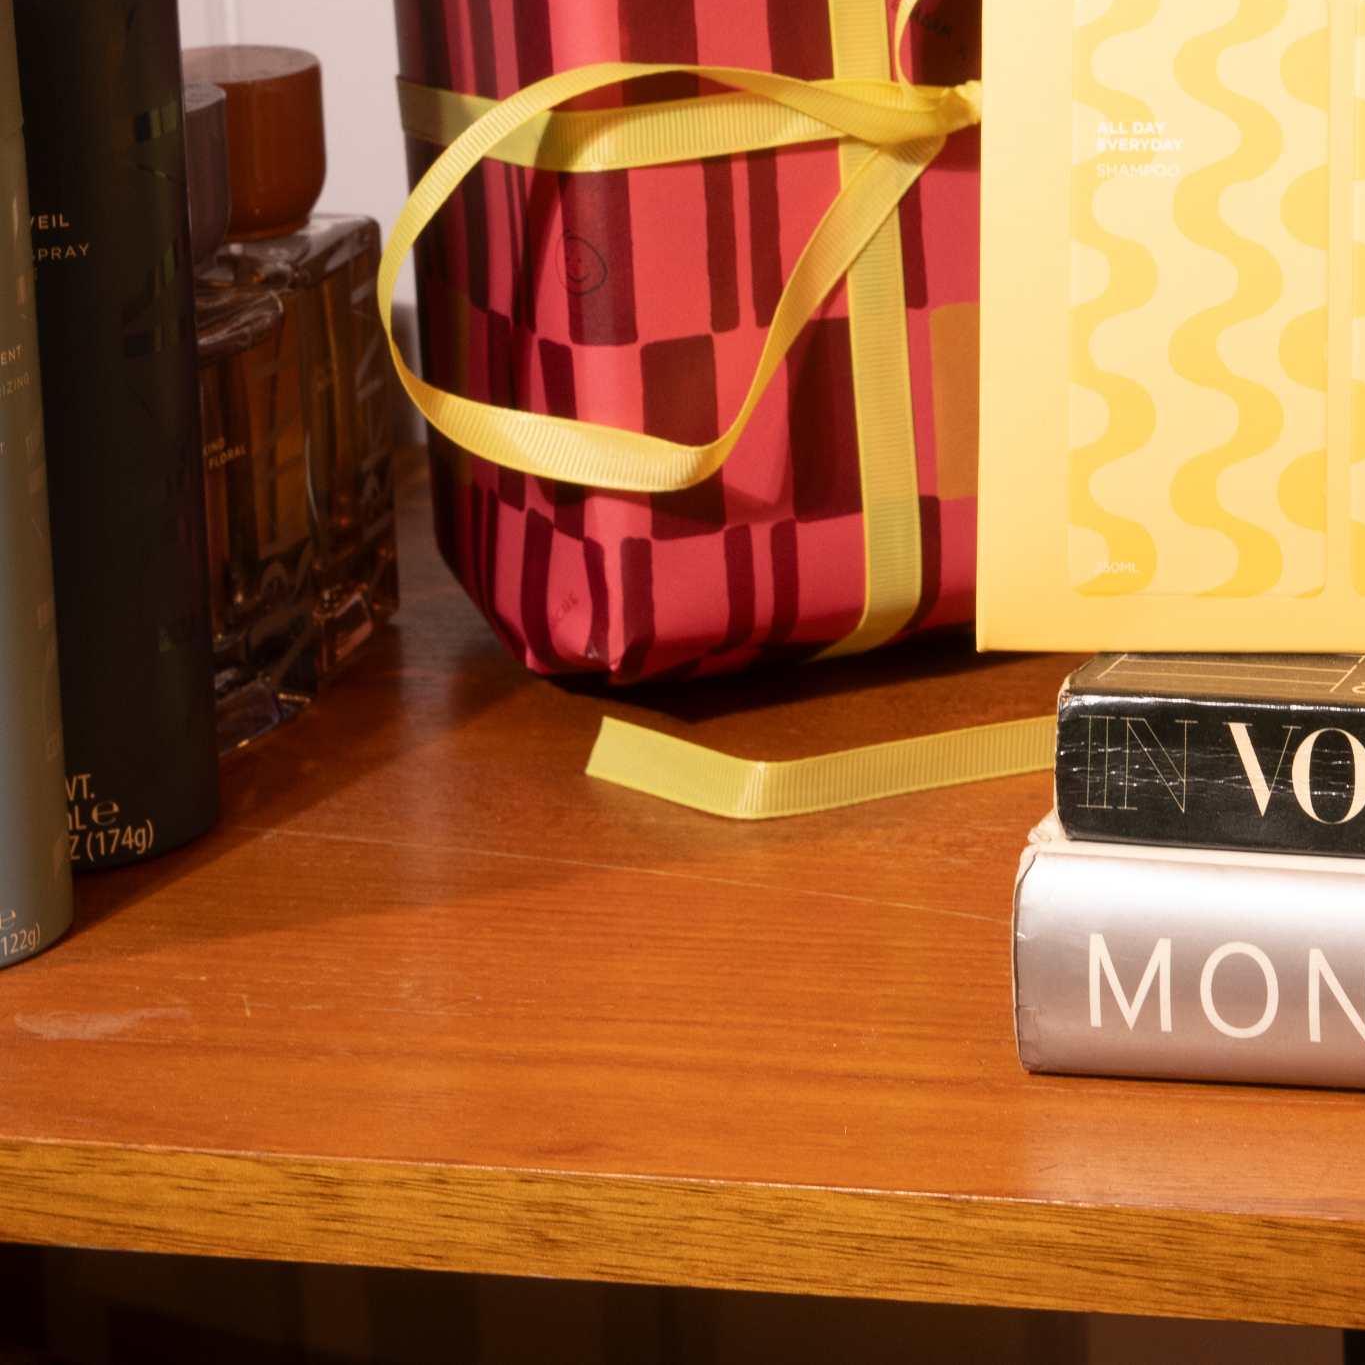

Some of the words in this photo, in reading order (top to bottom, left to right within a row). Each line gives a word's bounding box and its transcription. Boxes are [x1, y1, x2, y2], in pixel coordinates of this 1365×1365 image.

[1096, 121, 1128, 135] ALL
[1132, 121, 1166, 135] DAY
[1096, 138, 1184, 152] EVERYDAY
[1096, 163, 1180, 178] SHAMPOO
[33, 242, 90, 262] PRAY
[0, 371, 30, 397] IZING
[1094, 562, 1140, 575] 250ML
[1076, 714, 1199, 815] IN
[86, 819, 154, 862] (174g)
